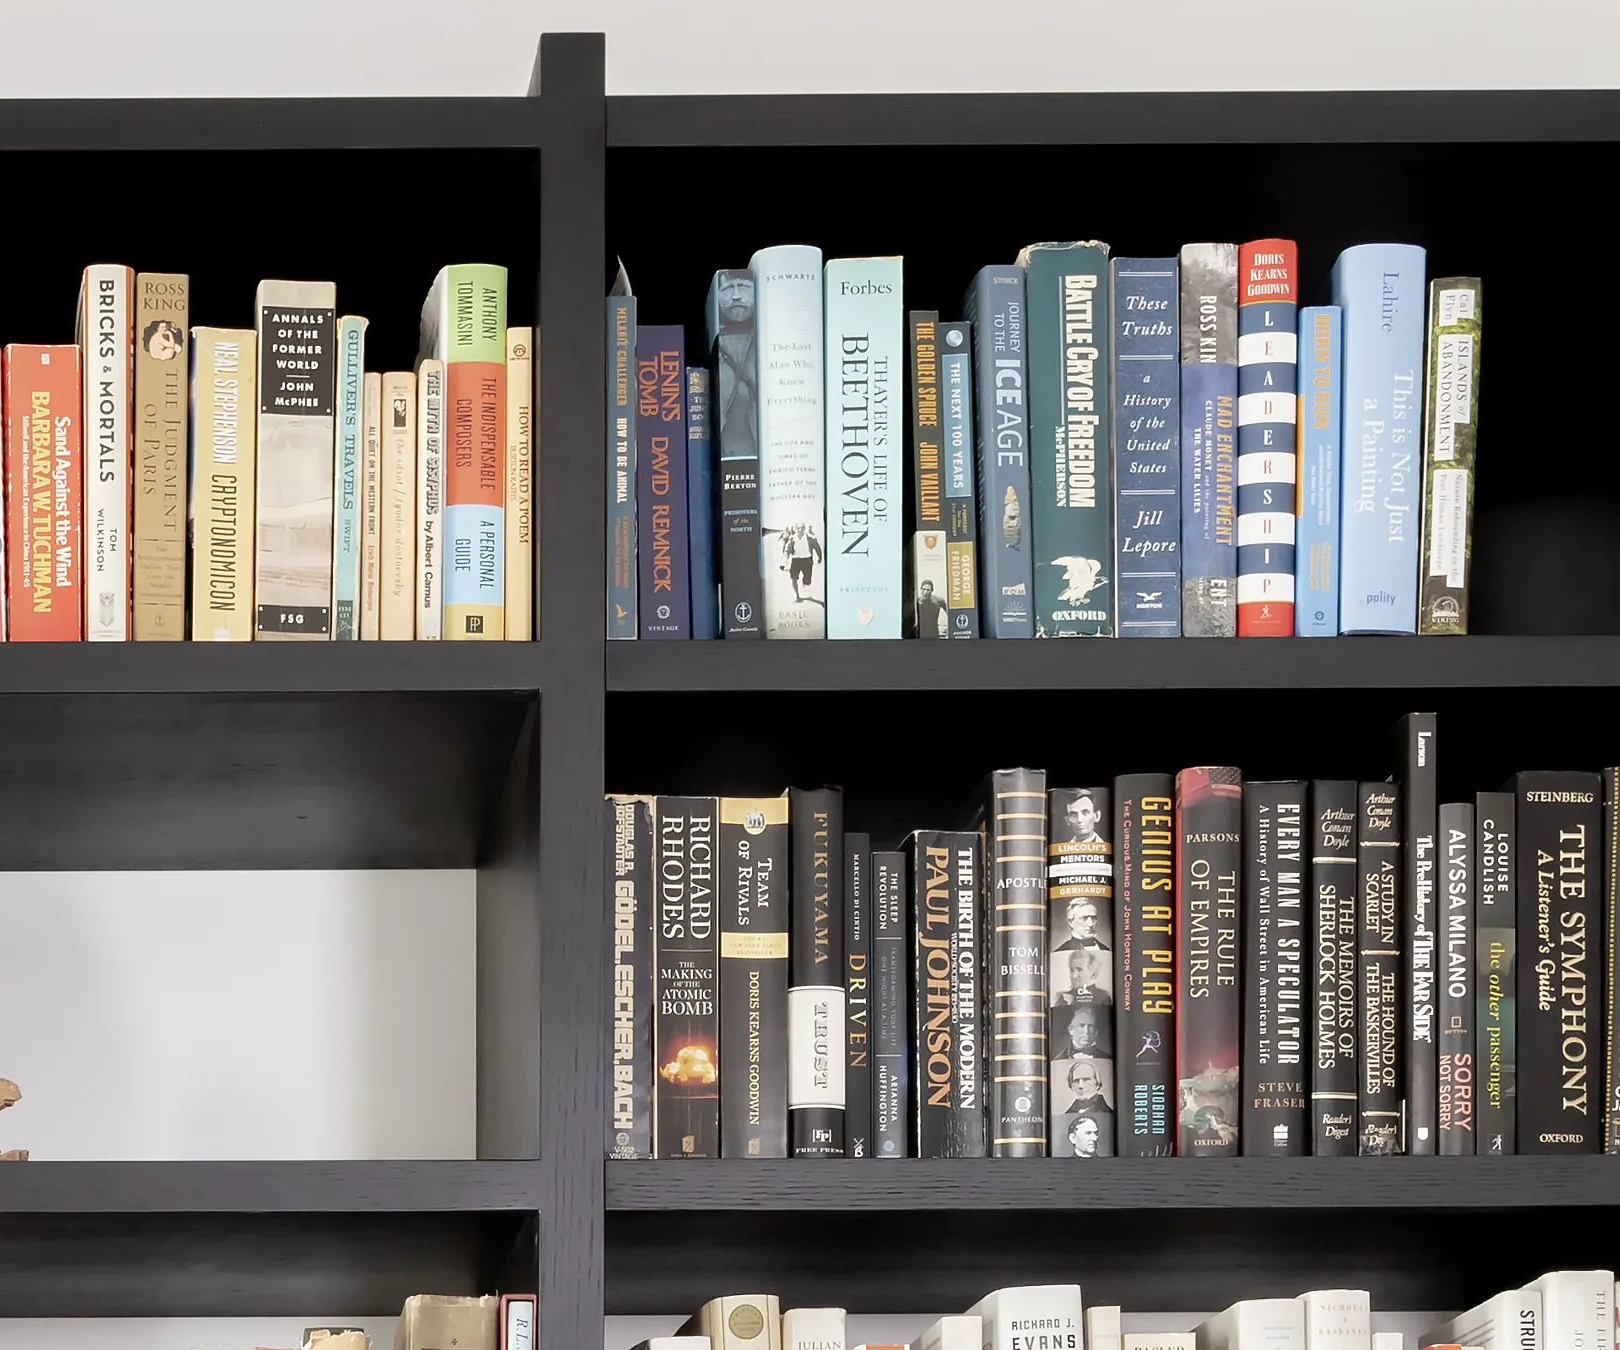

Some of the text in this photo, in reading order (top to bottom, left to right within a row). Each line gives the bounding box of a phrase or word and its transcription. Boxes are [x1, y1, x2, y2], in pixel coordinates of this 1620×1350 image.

[273, 314, 324, 324] ANNALS
[457, 281, 474, 346] TOMMASINI
[482, 288, 497, 342] ANTHONY
[840, 281, 892, 295] Forbes
[1127, 296, 1168, 309] These
[1380, 272, 1399, 332] Lahire
[272, 344, 322, 354] FORMER
[278, 330, 319, 339] OF THE
[1122, 322, 1172, 336] Truths
[99, 280, 115, 483] BRICKS & MORTALS
[277, 360, 319, 369] WORLD
[281, 382, 314, 392] JOHN
[639, 357, 658, 416] TOMB
[660, 351, 679, 421] LENIN'S
[1065, 275, 1099, 508] BATTLE CRY OF FREEDOM
[275, 398, 318, 407] McPHEE
[456, 399, 472, 467] COMPOSERS
[480, 378, 496, 490] THE INDISPENSABLE
[996, 358, 1023, 467] ICE AGE
[343, 330, 358, 552] GULLIVER'S TRAVELS SWIFT
[841, 334, 869, 557] BEETHOVEN
[1055, 425, 1066, 508] McPHERSON
[31, 391, 51, 612] BARBARA W. TUCHMAN
[53, 416, 71, 587] Sand Against the Wind
[652, 437, 670, 592] DAVID REMNICK
[1133, 511, 1163, 529] Jill
[96, 509, 105, 572] WILKINSON
[210, 475, 237, 611] CRYPTONOMICON
[1122, 538, 1176, 552] Lepore
[281, 614, 304, 623] FSG
[1051, 611, 1107, 622] OXFORD
[1527, 792, 1593, 802] STEINBERG
[662, 815, 683, 938] RHODES
[690, 815, 710, 938] RICHARD
[813, 812, 828, 965] FUKUYAMA
[1483, 819, 1494, 905] CANDLISH
[1497, 834, 1507, 892] LOUISE
[1141, 796, 1172, 1014] GENIUS AT PLAY
[1190, 859, 1210, 998] OF EMPIRES
[1217, 871, 1235, 986] THE RULE
[1448, 829, 1466, 998] ALYSSA MILANO
[1559, 824, 1587, 1114] THE SYMPHONY
[814, 1003, 828, 1088] TRUST
[849, 954, 866, 1068] DRIVEN
[1486, 942, 1503, 1109] the other passenger
[879, 1065, 888, 1132] HUFFINGTON
[890, 1075, 898, 1121] ARIANNA
[1013, 1335, 1076, 1350] EVANS
